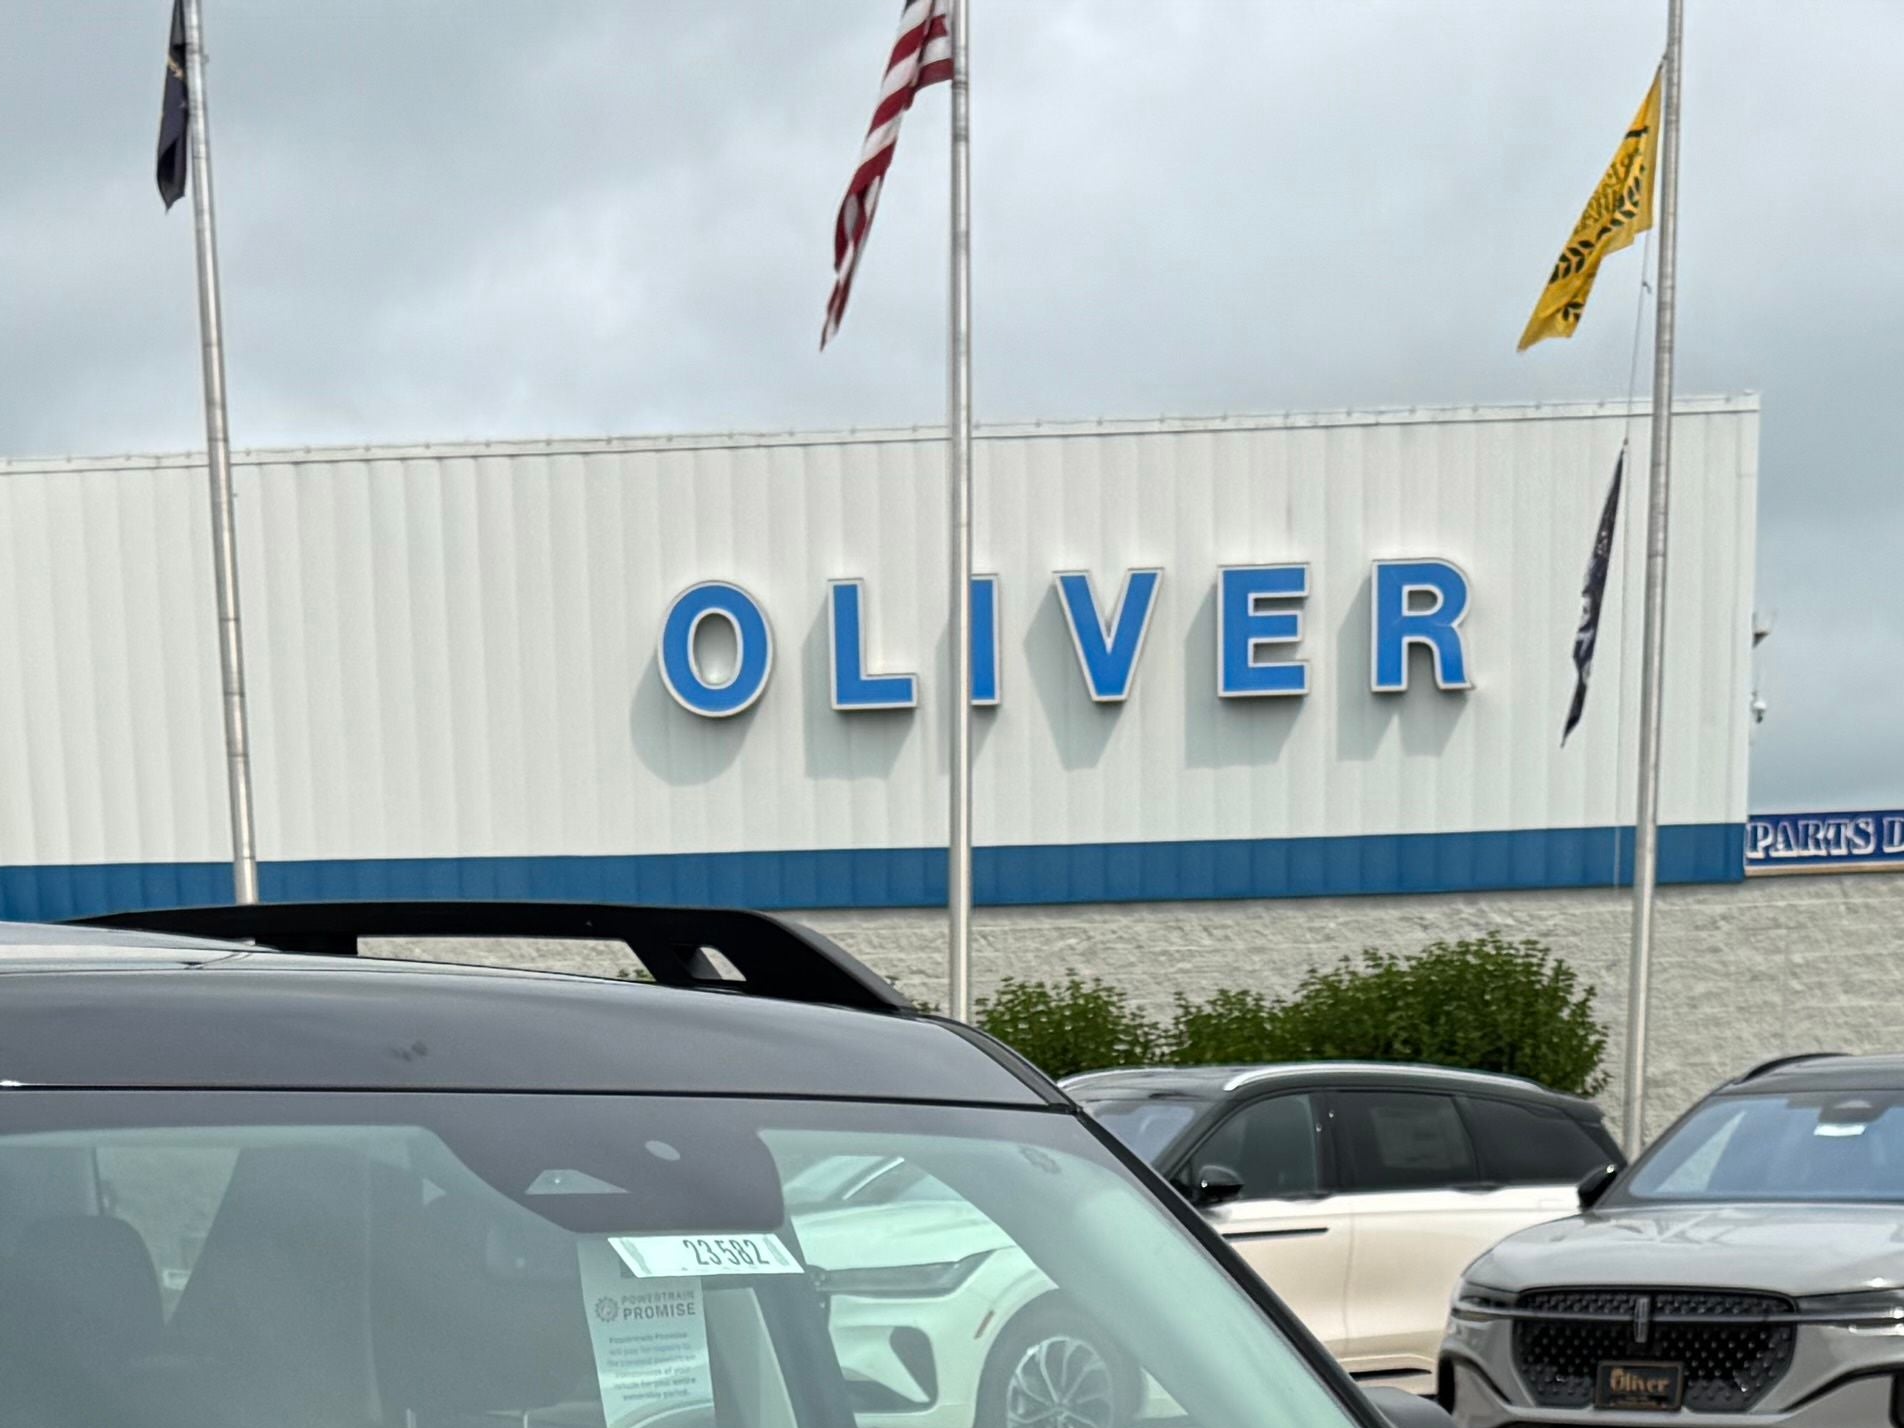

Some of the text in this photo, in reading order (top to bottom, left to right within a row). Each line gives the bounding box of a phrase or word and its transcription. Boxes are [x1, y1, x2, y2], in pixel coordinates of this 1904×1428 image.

[656, 557, 1476, 718] OLIVER
[1746, 818, 1877, 860] PARTS
[682, 1239, 770, 1266] 23582
[623, 1302, 696, 1321] PROMISE
